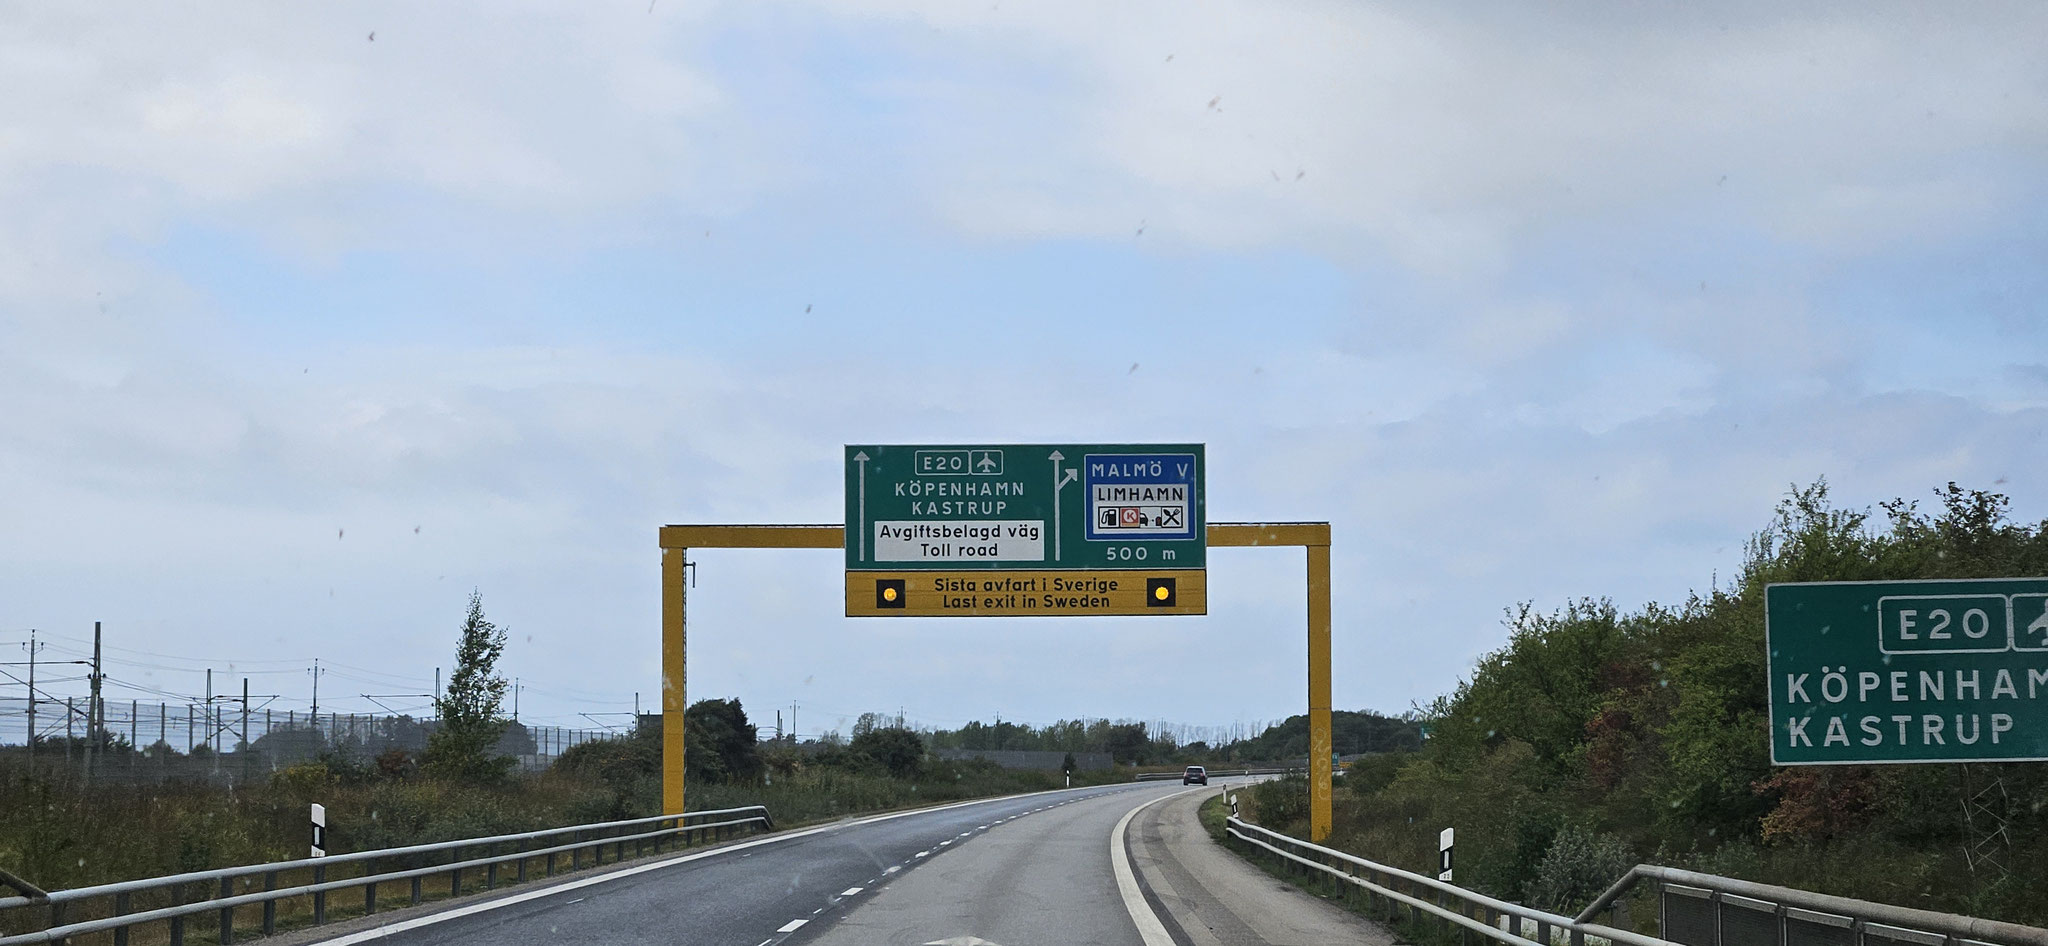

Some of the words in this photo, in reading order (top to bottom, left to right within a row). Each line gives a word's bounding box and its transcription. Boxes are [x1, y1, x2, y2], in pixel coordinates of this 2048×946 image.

[924, 457, 962, 470] E20
[1092, 461, 1163, 477] MALMÖ
[1176, 464, 1188, 477] V
[895, 480, 1024, 497] KÖPENHAMN
[1098, 488, 1183, 501] LIMHAMN
[912, 501, 1008, 515] KASTRUP
[880, 525, 1001, 541] Avgiftsbelagd
[1008, 525, 1039, 541] väg
[921, 544, 950, 557] Toll
[959, 544, 998, 557] road
[1107, 547, 1148, 560] 500
[1162, 550, 1176, 560] m
[934, 578, 976, 592] Sista
[983, 578, 1036, 592] avfart
[1043, 578, 1047, 591] i
[1053, 578, 1118, 594] Sverige
[943, 595, 977, 608] Last
[984, 595, 1017, 608] exit
[1023, 595, 1036, 608] in
[1043, 595, 1110, 608] Sweden
[1900, 609, 1989, 640] E20
[1789, 713, 2014, 748] KASTRUP
